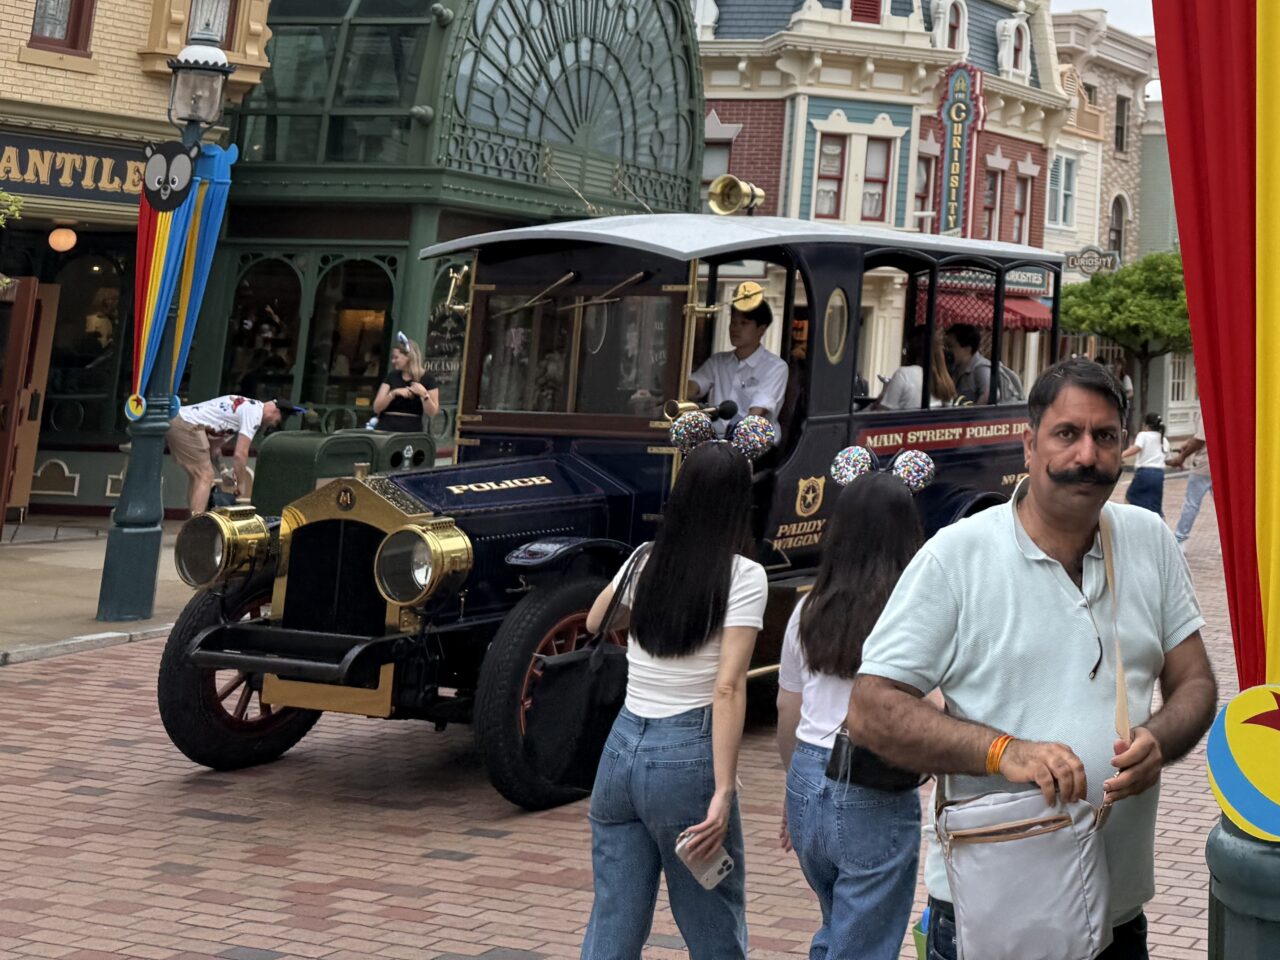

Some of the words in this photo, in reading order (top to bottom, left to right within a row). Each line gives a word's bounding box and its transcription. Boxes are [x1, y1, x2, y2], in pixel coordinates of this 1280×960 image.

[947, 102, 967, 228] CURIOSITY
[1068, 255, 1113, 269] CURIOSITY
[866, 434, 903, 448] MAIN
[907, 428, 963, 443] STREET
[966, 424, 1010, 438] POLICE
[446, 476, 552, 495] POLICE
[776, 519, 826, 538] PADDY
[772, 532, 823, 551] WAGON
